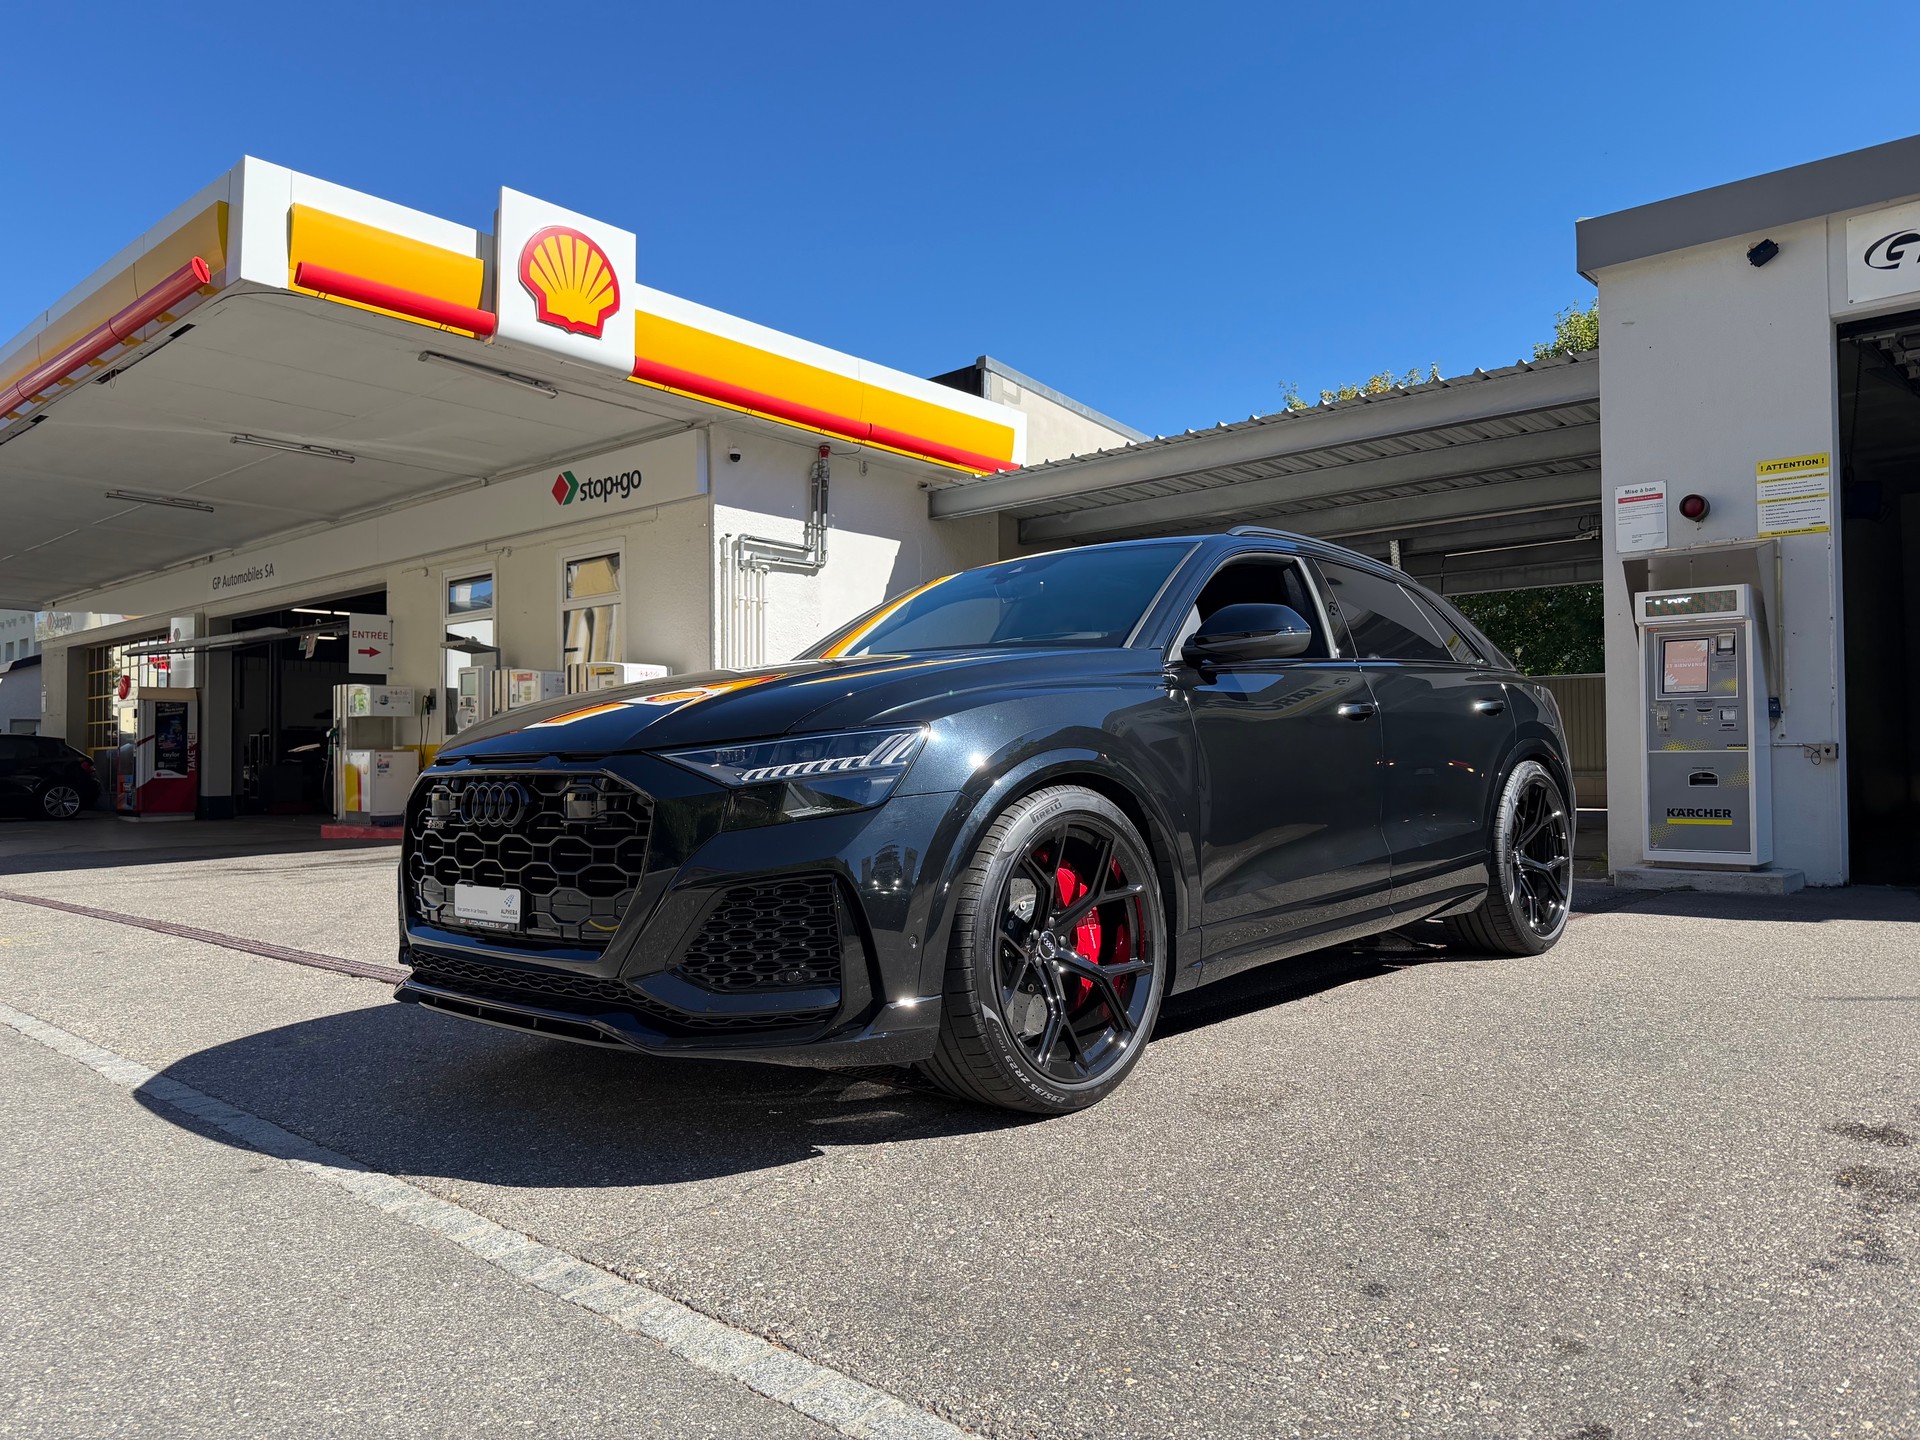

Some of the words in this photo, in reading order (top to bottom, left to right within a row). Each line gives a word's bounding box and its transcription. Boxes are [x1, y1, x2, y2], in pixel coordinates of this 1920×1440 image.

[1766, 458, 1818, 471] ATTENTION
[580, 470, 642, 502] stop+go
[213, 576, 221, 590] GP
[222, 566, 263, 588] Automobiles
[264, 563, 274, 578] SA
[352, 630, 388, 640] ENTRÉE
[187, 750, 196, 772] TAKE
[1029, 798, 1062, 824] PIRELLI
[1667, 808, 1732, 818] KÄRCHER
[1005, 1055, 1030, 1084] ZR23
[1029, 1083, 1066, 1103] 295/35
